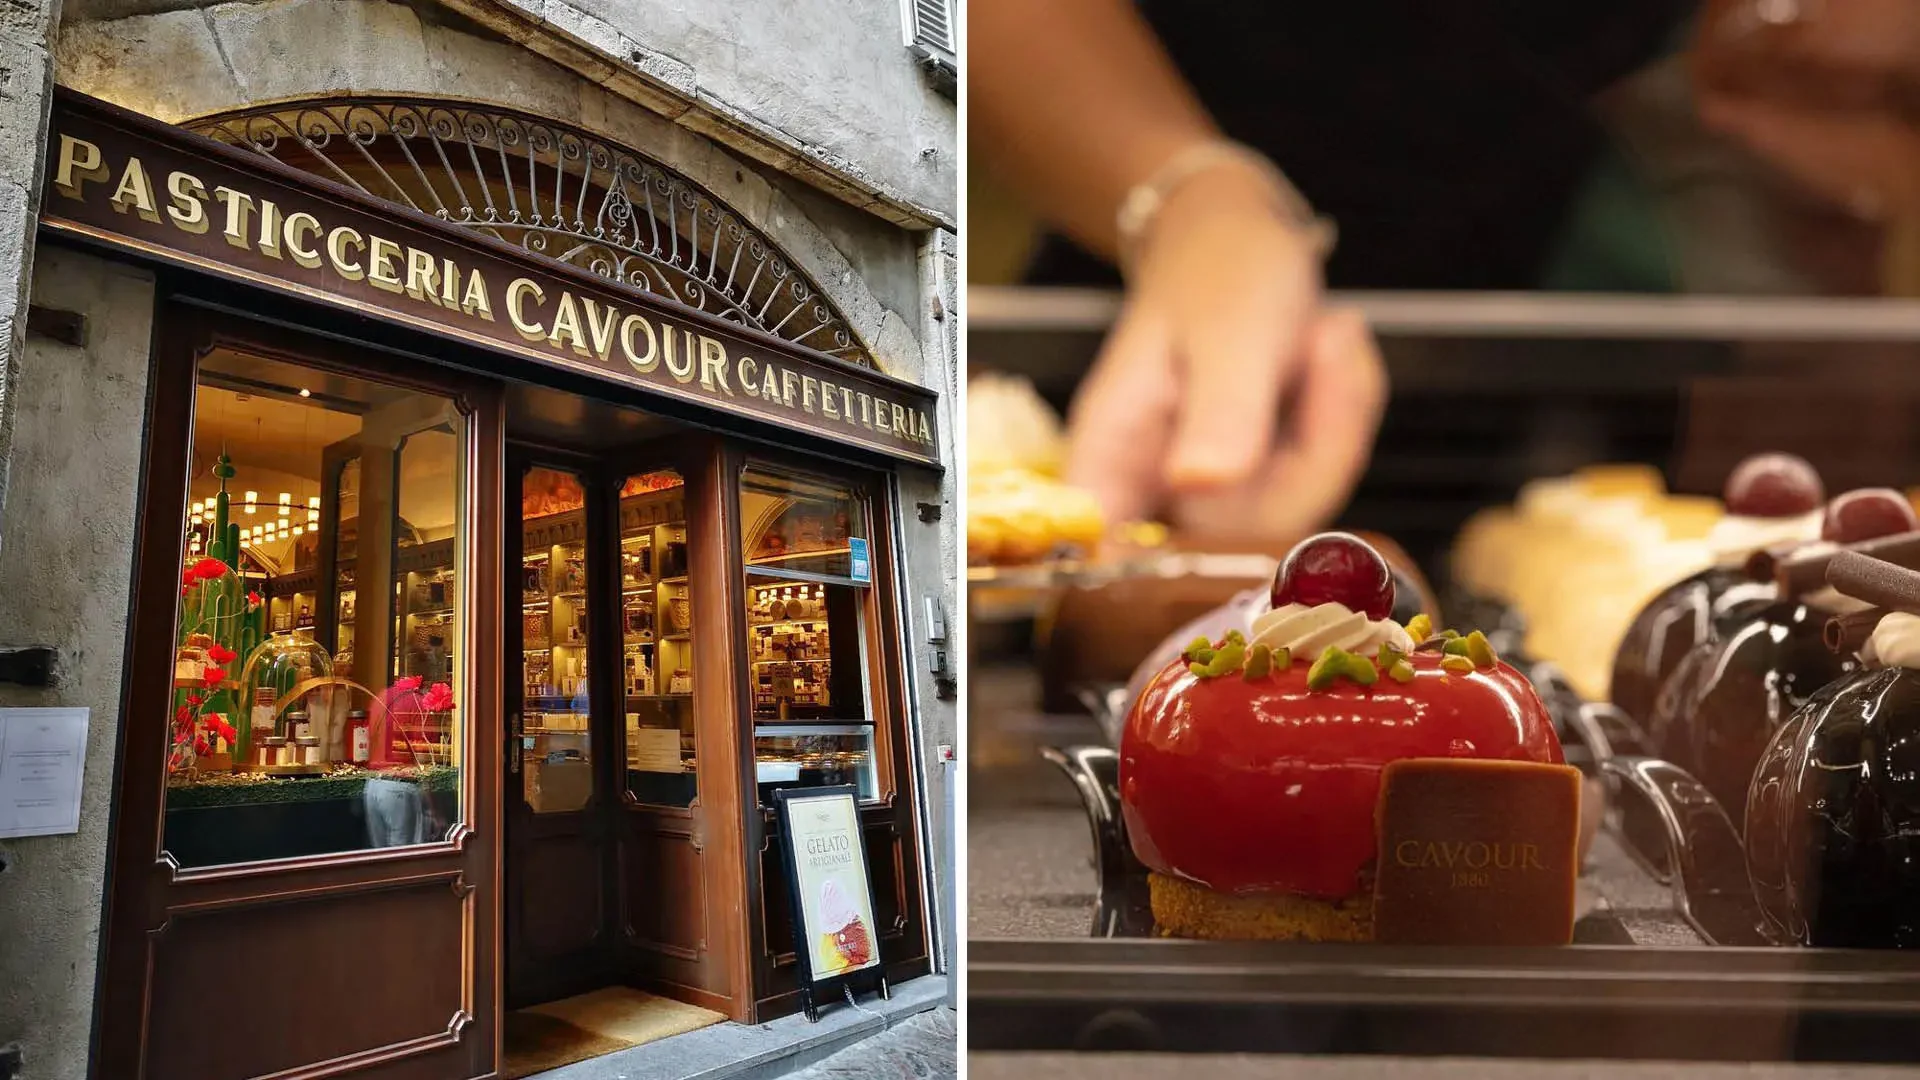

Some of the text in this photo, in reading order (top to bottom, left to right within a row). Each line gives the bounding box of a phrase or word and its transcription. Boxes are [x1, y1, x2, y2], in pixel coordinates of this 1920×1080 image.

[54, 134, 934, 447] PASTICCERIA CAVOUR CAFFETTERIA
[806, 834, 849, 855] GELATO
[1395, 839, 1545, 871] CAVOUR
